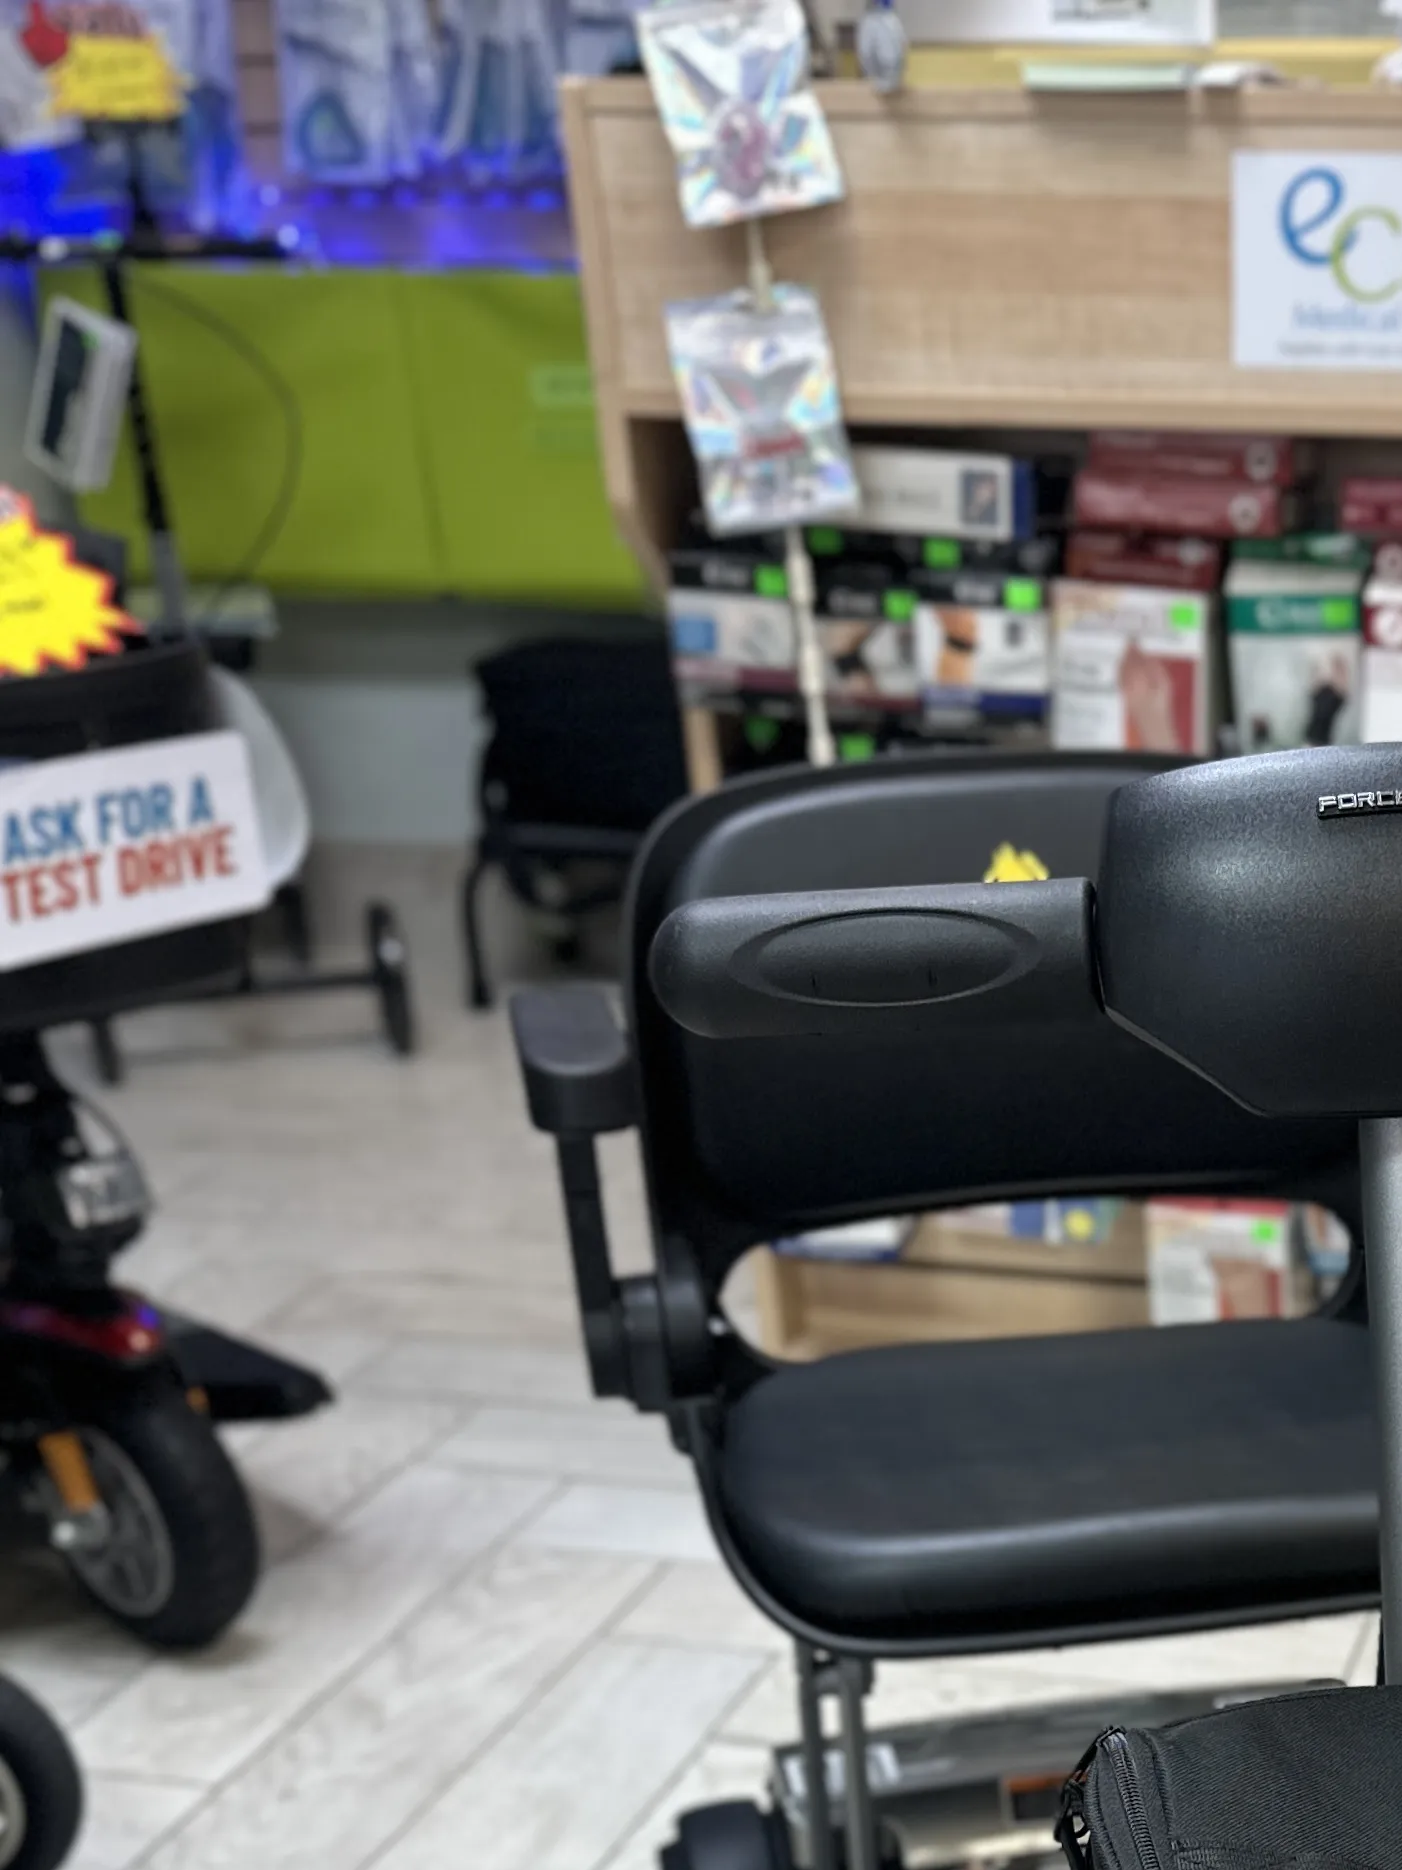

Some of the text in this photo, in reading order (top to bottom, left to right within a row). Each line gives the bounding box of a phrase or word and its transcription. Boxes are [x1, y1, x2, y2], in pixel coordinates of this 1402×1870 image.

[3, 773, 215, 864] ASK FOR A
[0, 823, 240, 924] TEST DRIVE
